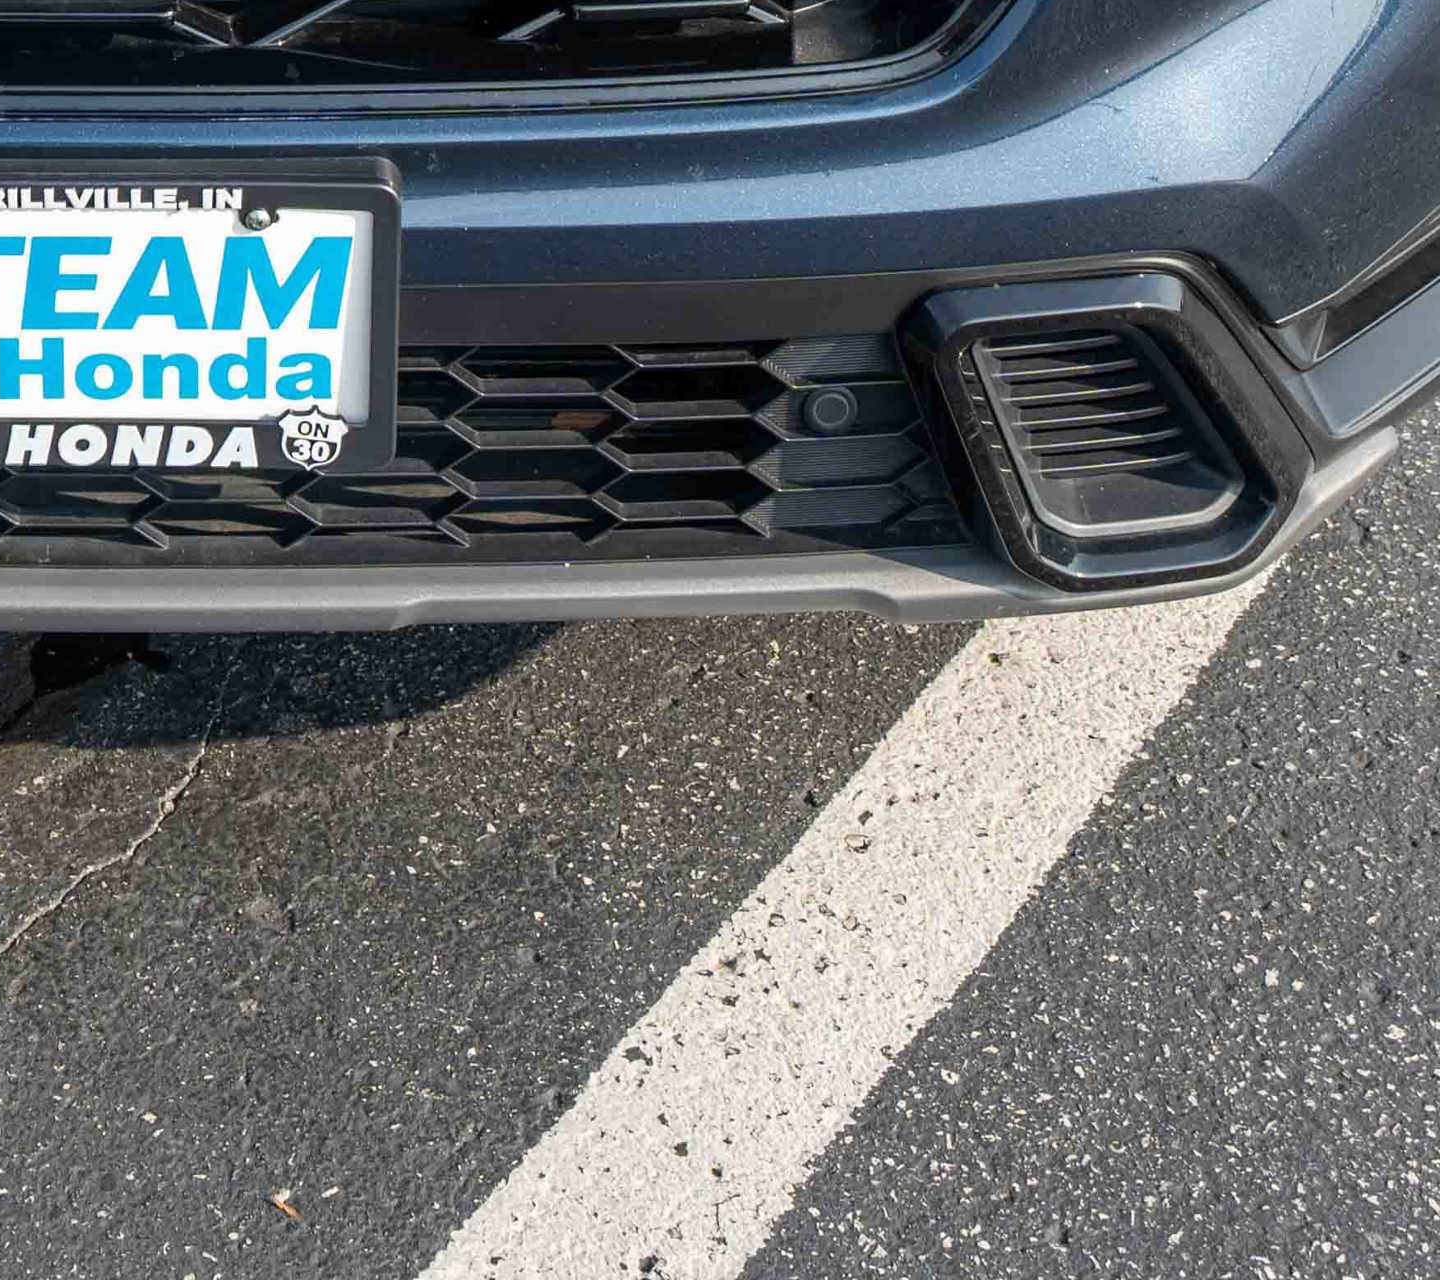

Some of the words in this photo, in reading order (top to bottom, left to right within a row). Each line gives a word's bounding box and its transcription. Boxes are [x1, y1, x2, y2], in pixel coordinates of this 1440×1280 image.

[202, 187, 244, 210] IN
[297, 420, 330, 439] ON
[4, 425, 259, 469] HONDA
[291, 439, 331, 462] 30
